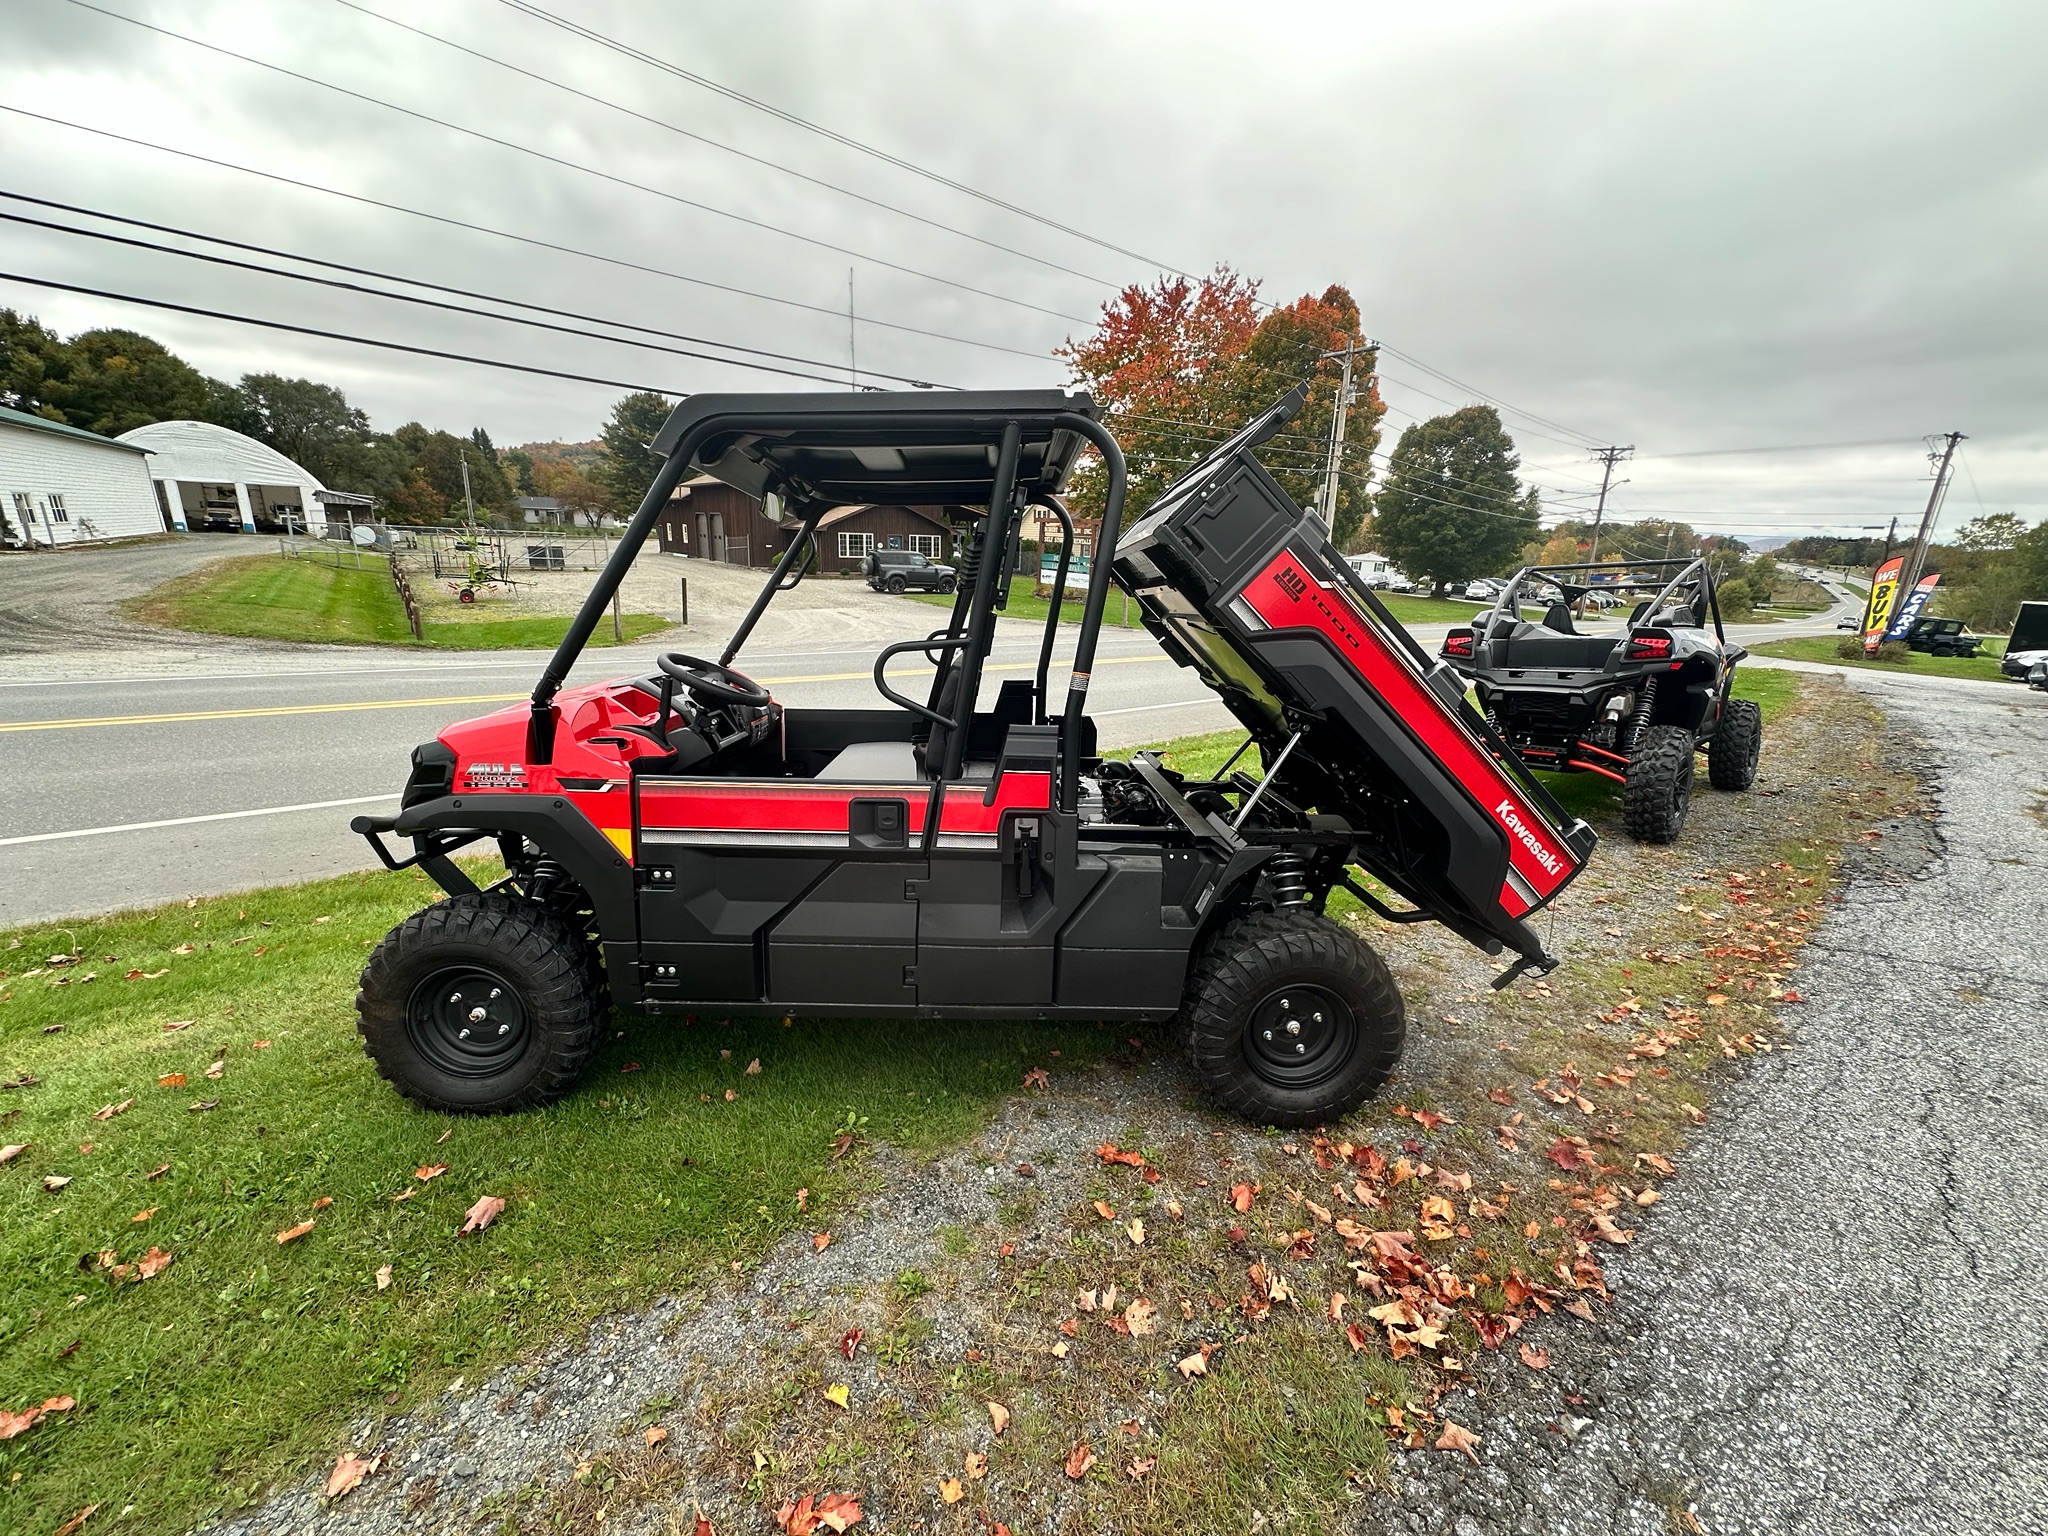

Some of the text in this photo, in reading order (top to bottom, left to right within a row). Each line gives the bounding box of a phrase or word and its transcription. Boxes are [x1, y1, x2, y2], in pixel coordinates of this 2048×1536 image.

[1275, 576, 1299, 601] EDITION
[1281, 566, 1308, 595] HD
[1877, 569, 1898, 582] WE
[1310, 593, 1360, 649] 1000
[1870, 585, 1891, 629] BUY
[1890, 593, 1927, 635] CARS
[1865, 634, 1881, 645] ARS
[465, 763, 526, 776] MULE
[1495, 799, 1564, 876] Kawasaki
